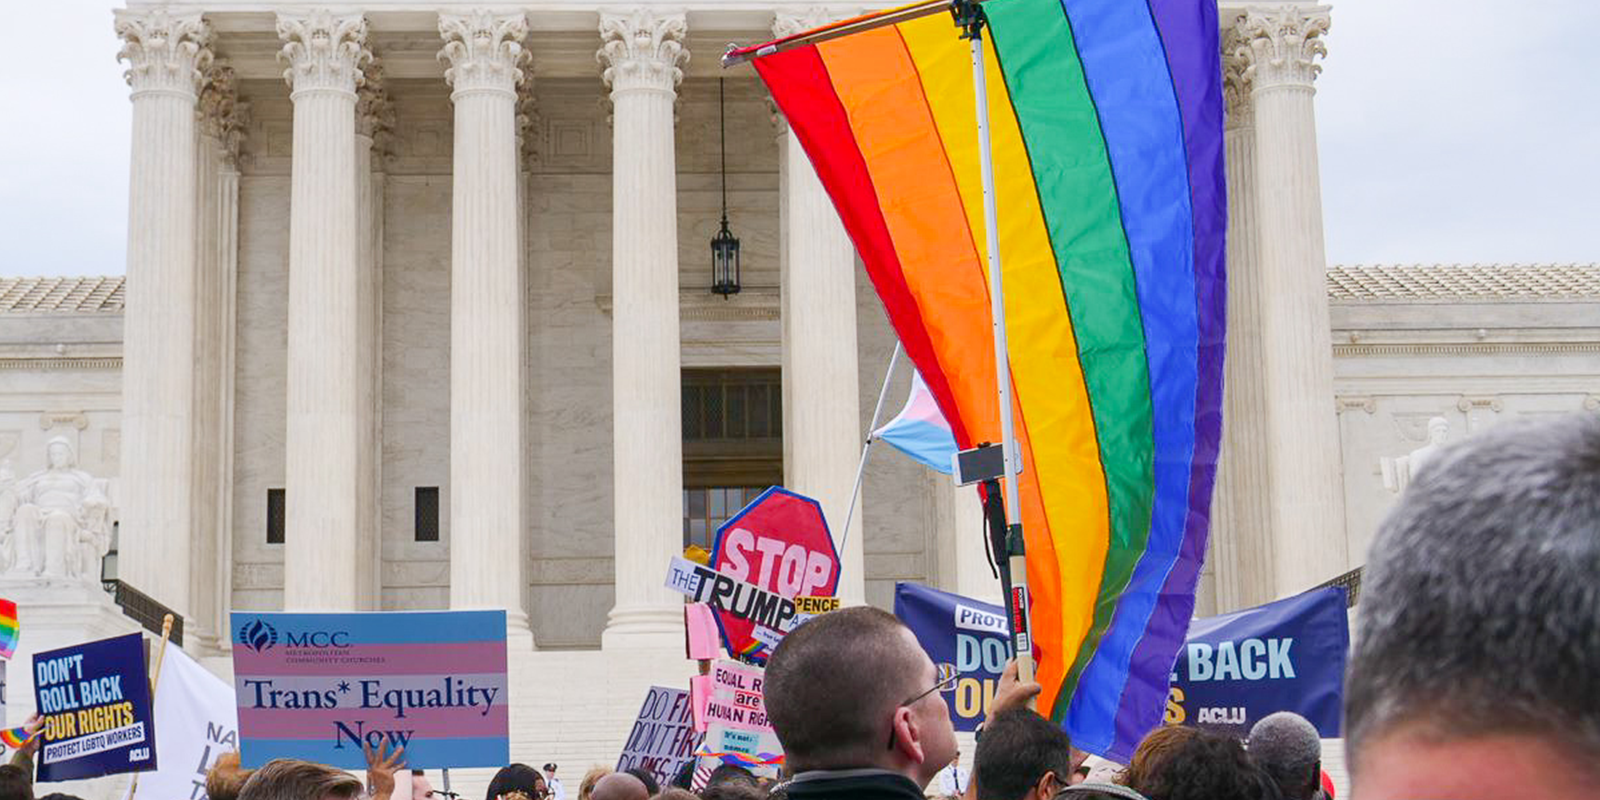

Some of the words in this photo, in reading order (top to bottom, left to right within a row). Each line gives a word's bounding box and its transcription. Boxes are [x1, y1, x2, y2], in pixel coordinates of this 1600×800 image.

[721, 528, 832, 598] STOP
[673, 567, 699, 592] THE
[693, 566, 796, 632] TRUMP
[795, 597, 839, 612] PENCE
[37, 654, 84, 687] DON'T
[1187, 638, 1296, 682] BACK
[40, 684, 79, 713] ROLL
[80, 675, 123, 706] BACK
[716, 668, 746, 690] EQUAL
[359, 676, 499, 718] Equality
[640, 689, 669, 720] DO
[707, 702, 745, 723] HUMAN
[736, 693, 760, 708] are
[45, 712, 77, 741] OUR
[78, 702, 134, 735] RIGHTS
[1197, 707, 1247, 725] ACLU
[46, 741, 81, 761] PROTECT
[82, 734, 105, 752] LGBTQ
[106, 725, 142, 745] WORKERS
[333, 721, 415, 750] Now
[129, 747, 151, 762] ACLU
